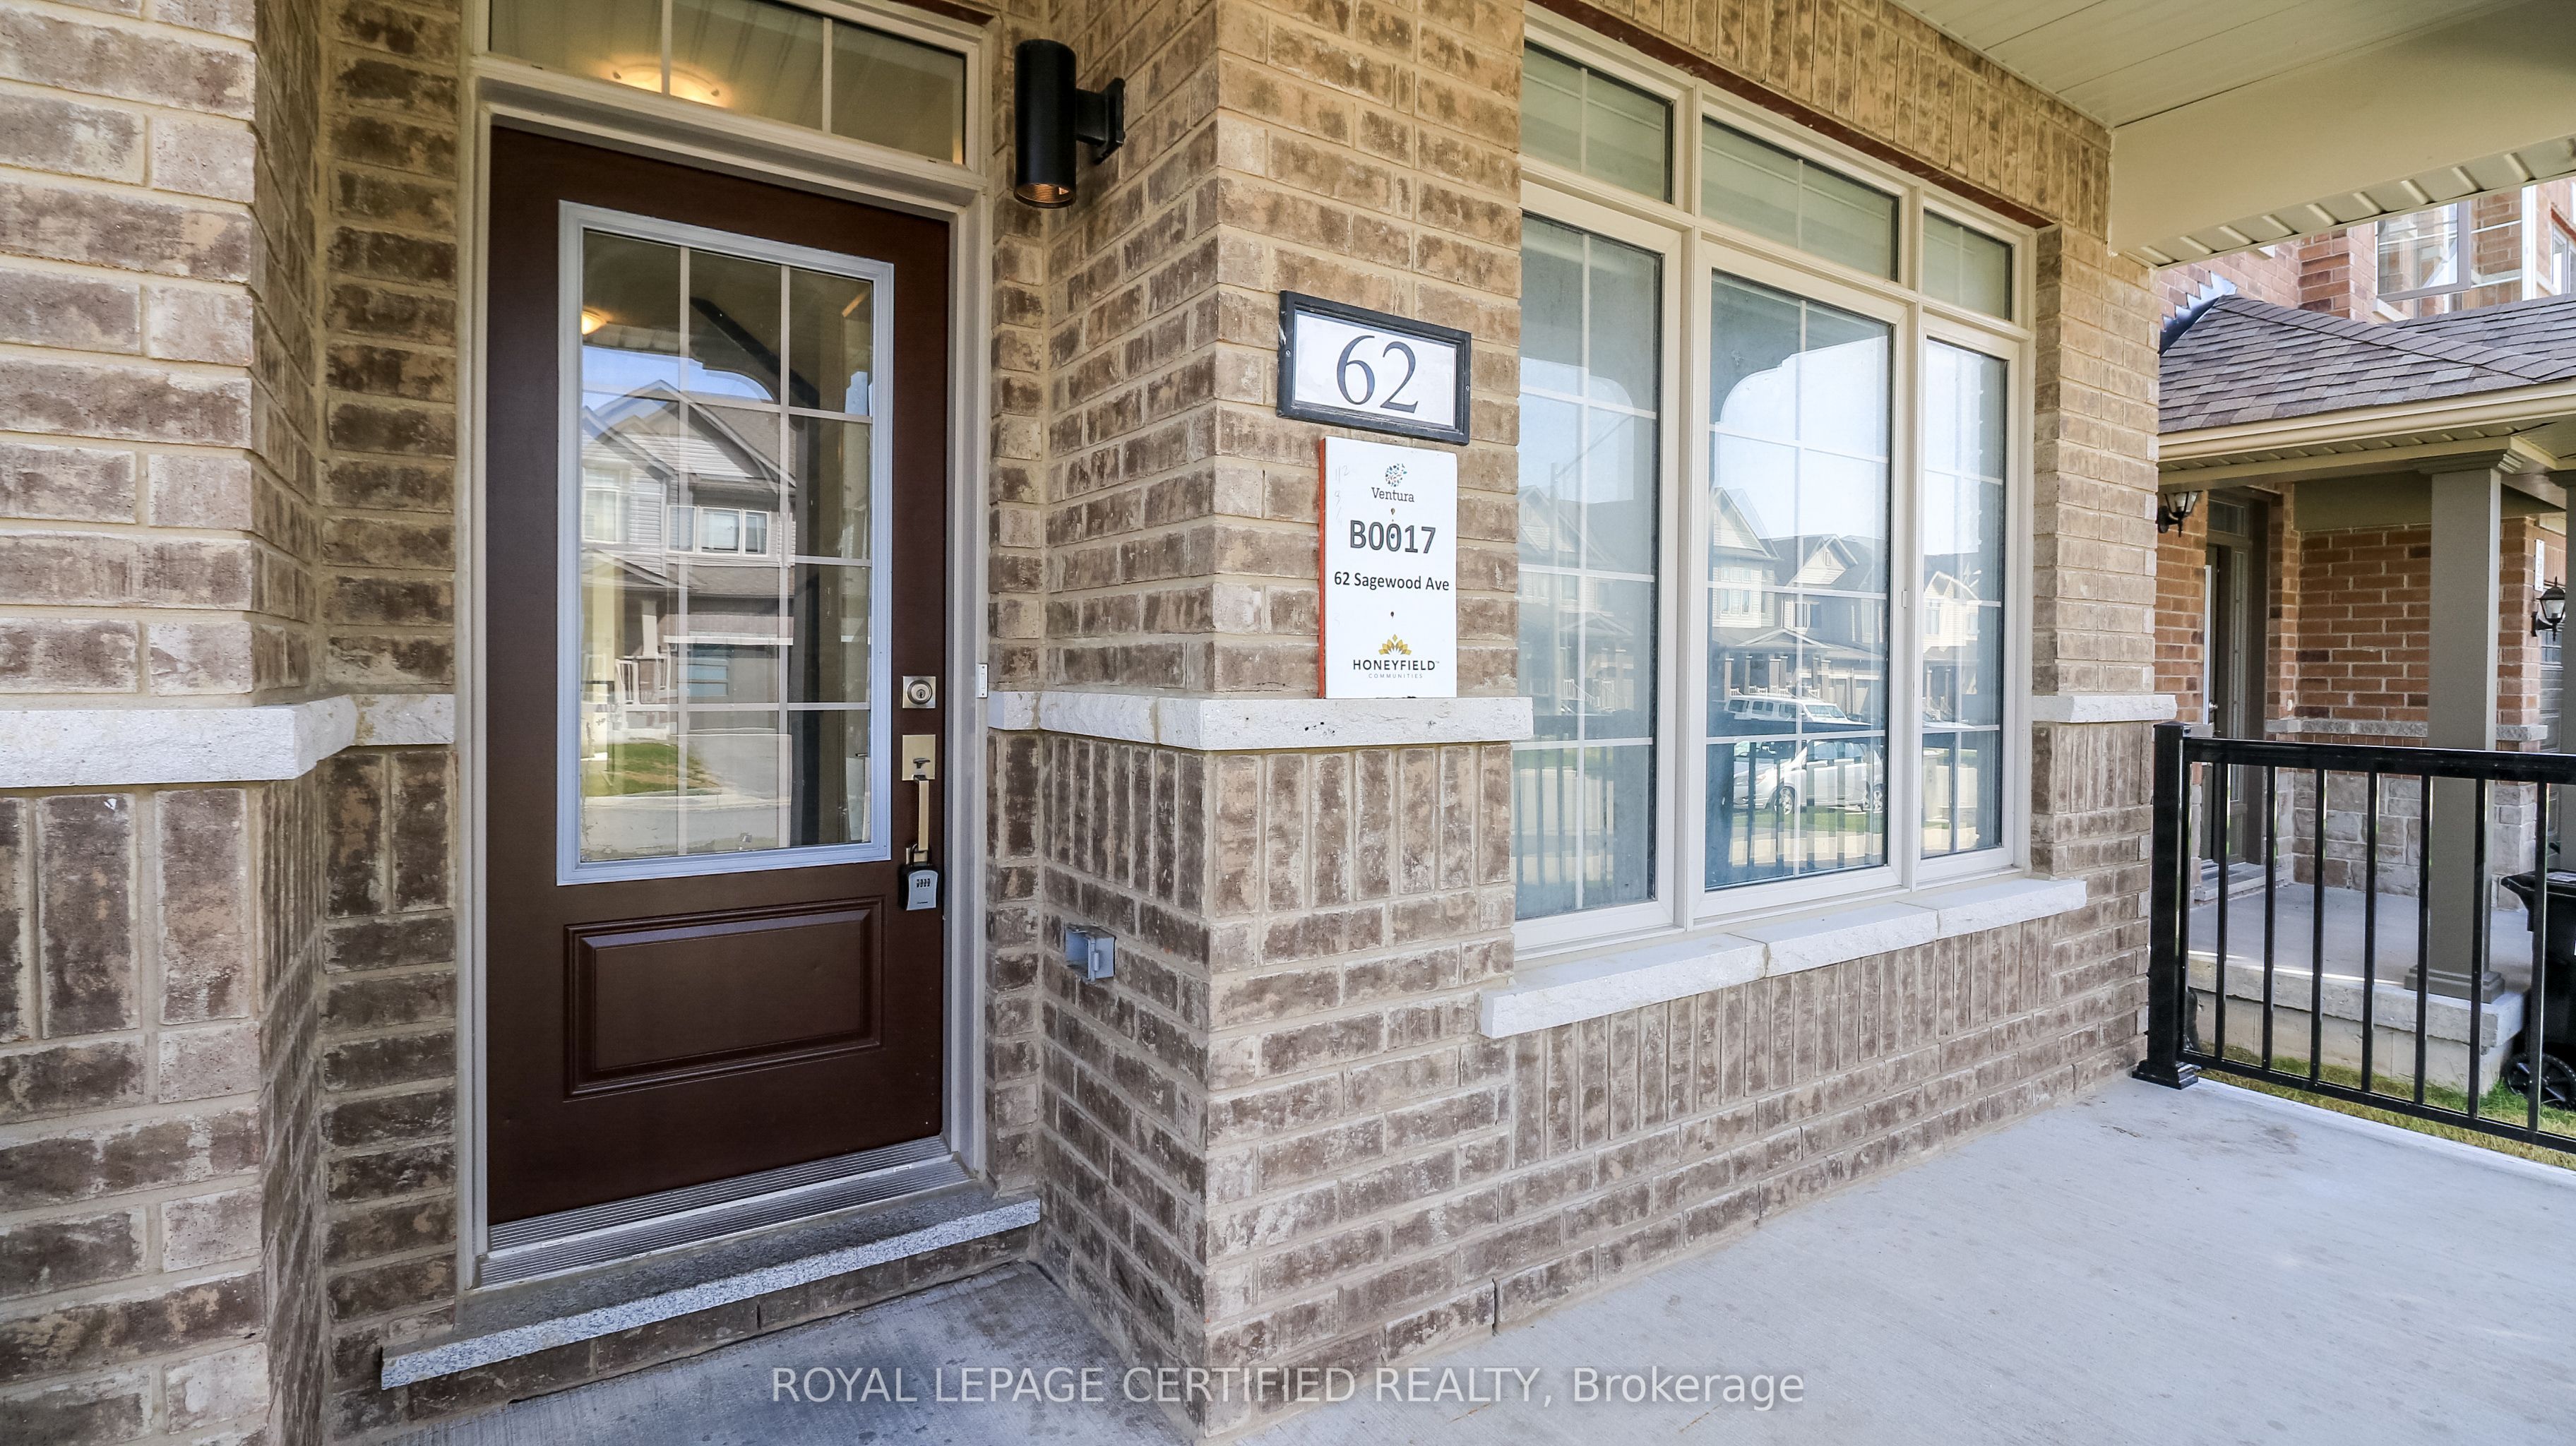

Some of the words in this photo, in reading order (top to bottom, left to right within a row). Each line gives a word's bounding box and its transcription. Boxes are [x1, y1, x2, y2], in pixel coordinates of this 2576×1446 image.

[1337, 335, 1419, 414] 62
[1371, 486, 1415, 503] Ventura
[1350, 520, 1436, 554] B0017
[1334, 570, 1350, 586] 62
[1354, 572, 1421, 590] Sagewood
[1425, 577, 1450, 591] Ave
[1353, 659, 1436, 671] HONEYFIELD
